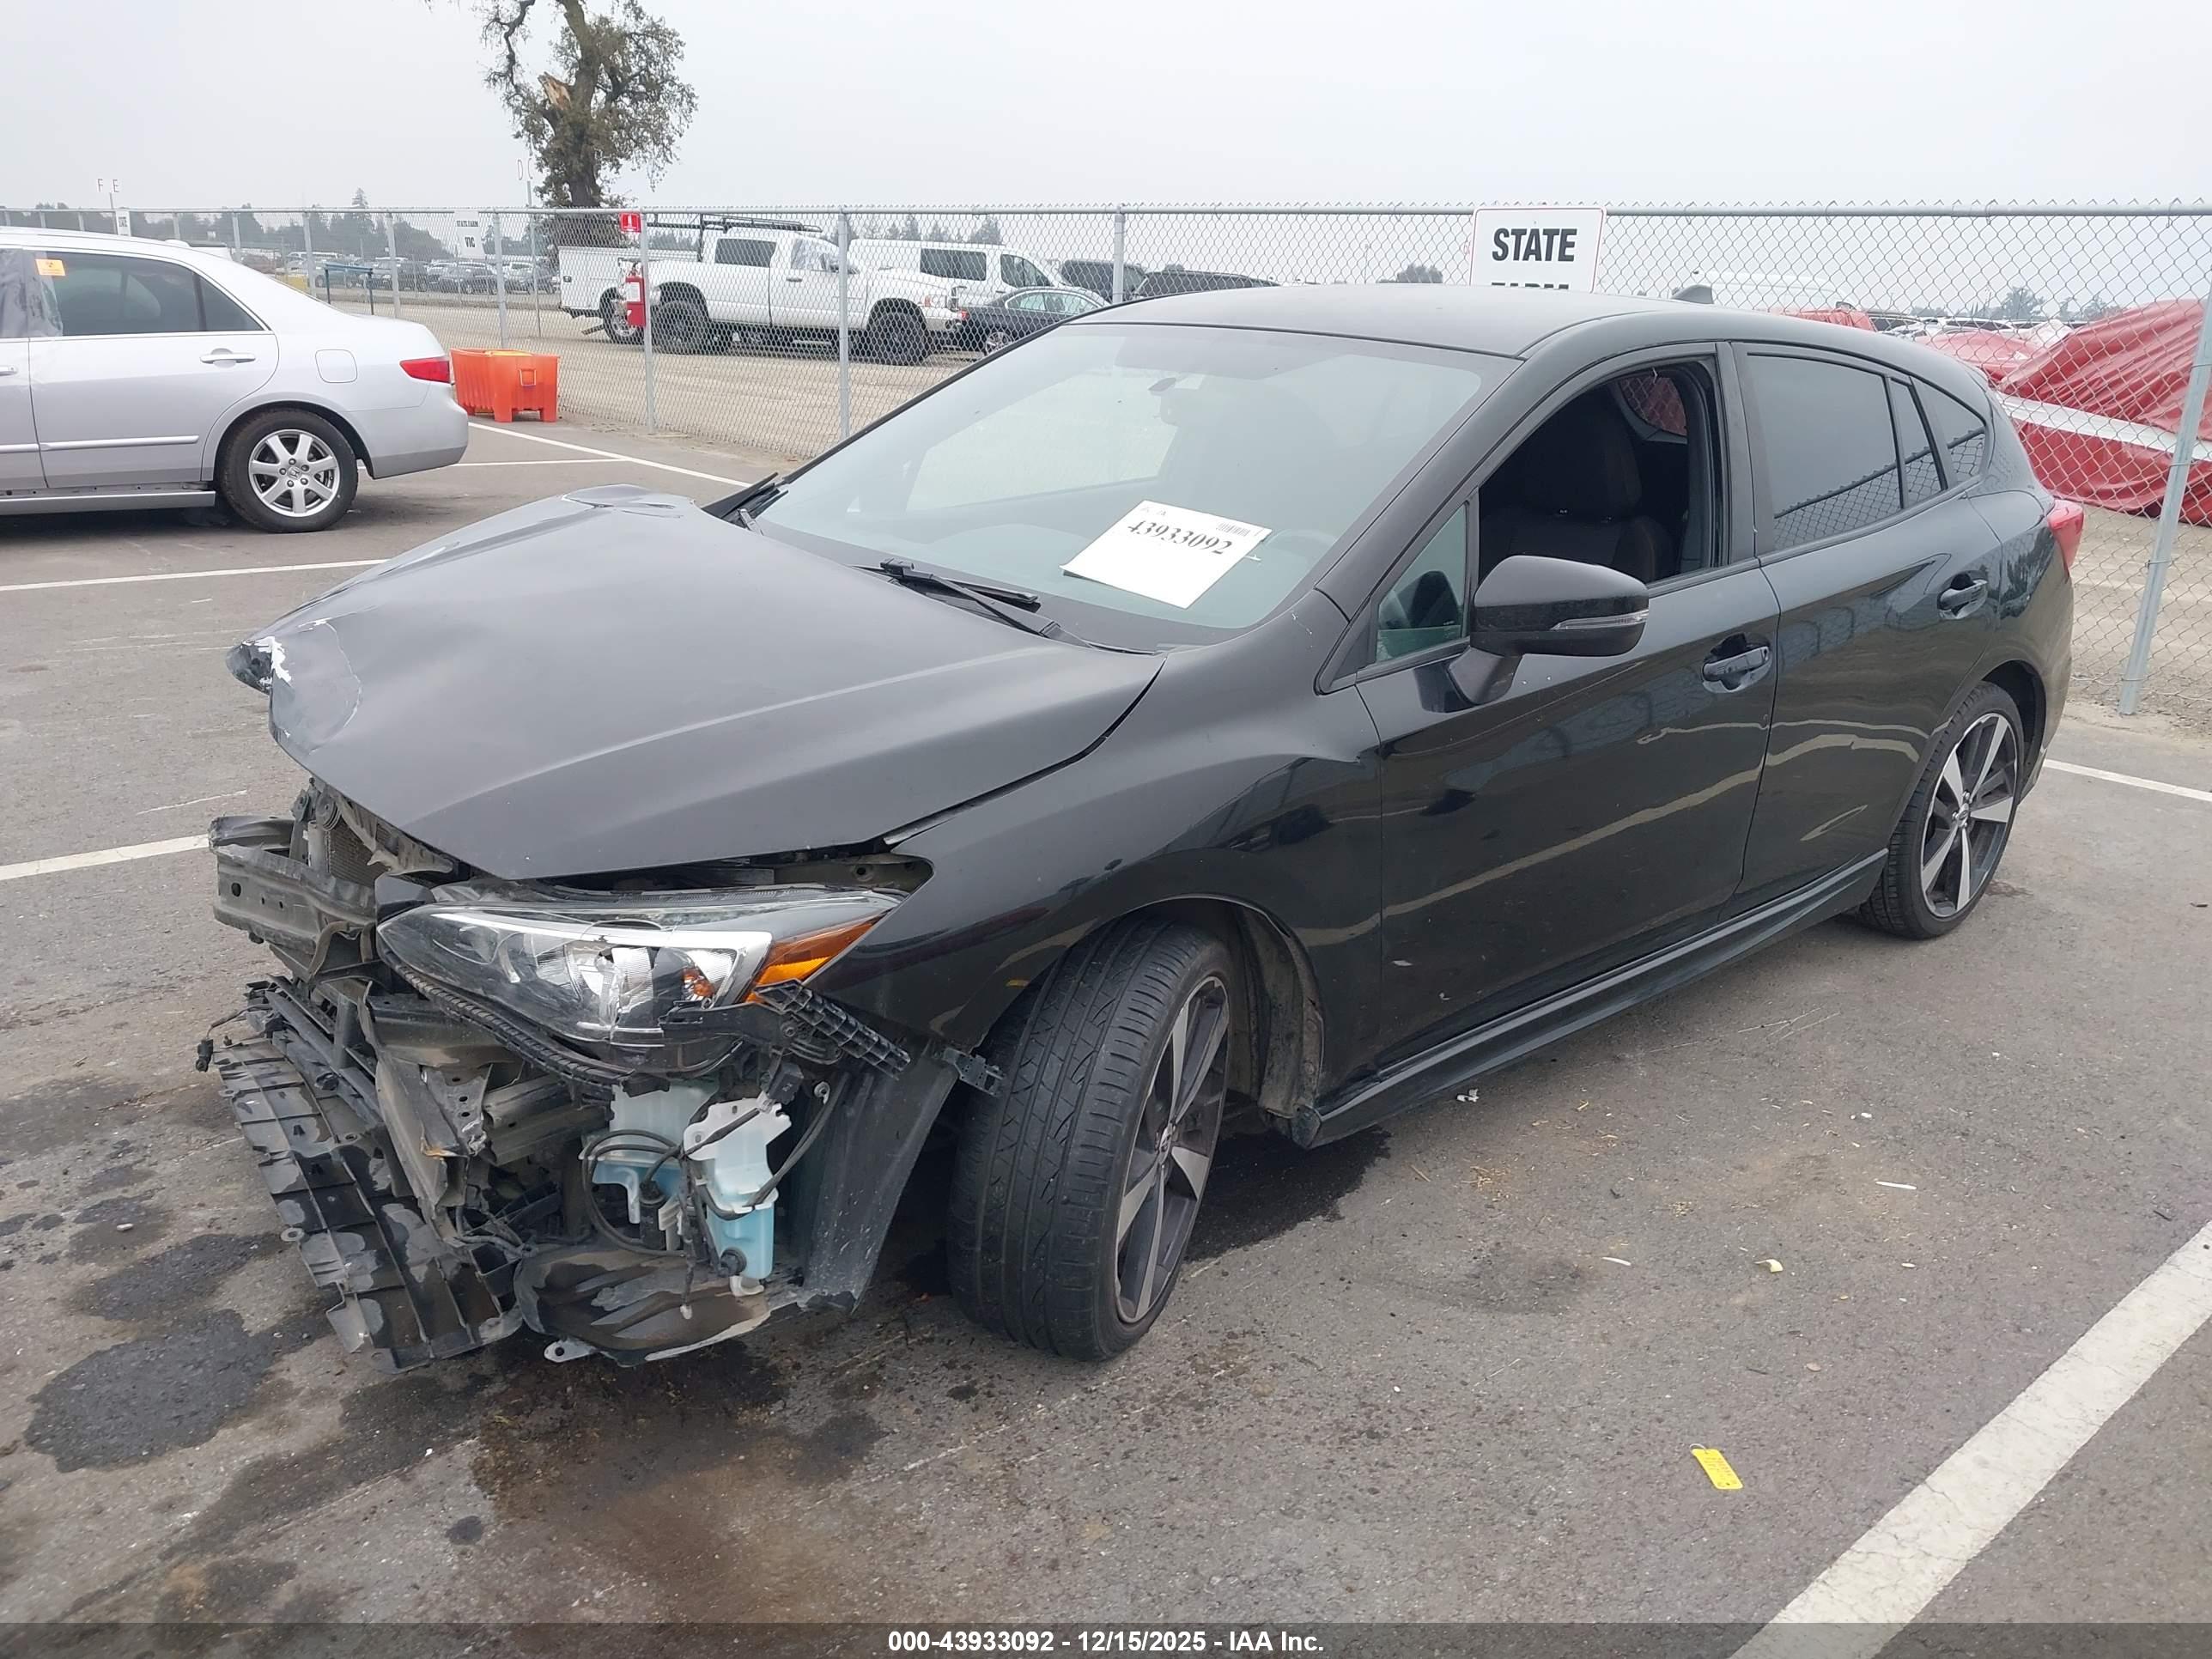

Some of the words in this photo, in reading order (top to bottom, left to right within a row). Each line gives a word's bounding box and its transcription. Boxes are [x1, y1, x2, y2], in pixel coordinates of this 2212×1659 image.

[97, 178, 104, 193] F
[112, 179, 120, 193] E
[465, 236, 476, 248] VIC
[1492, 228, 1577, 262] STATE
[1127, 520, 1233, 555] 43933092
